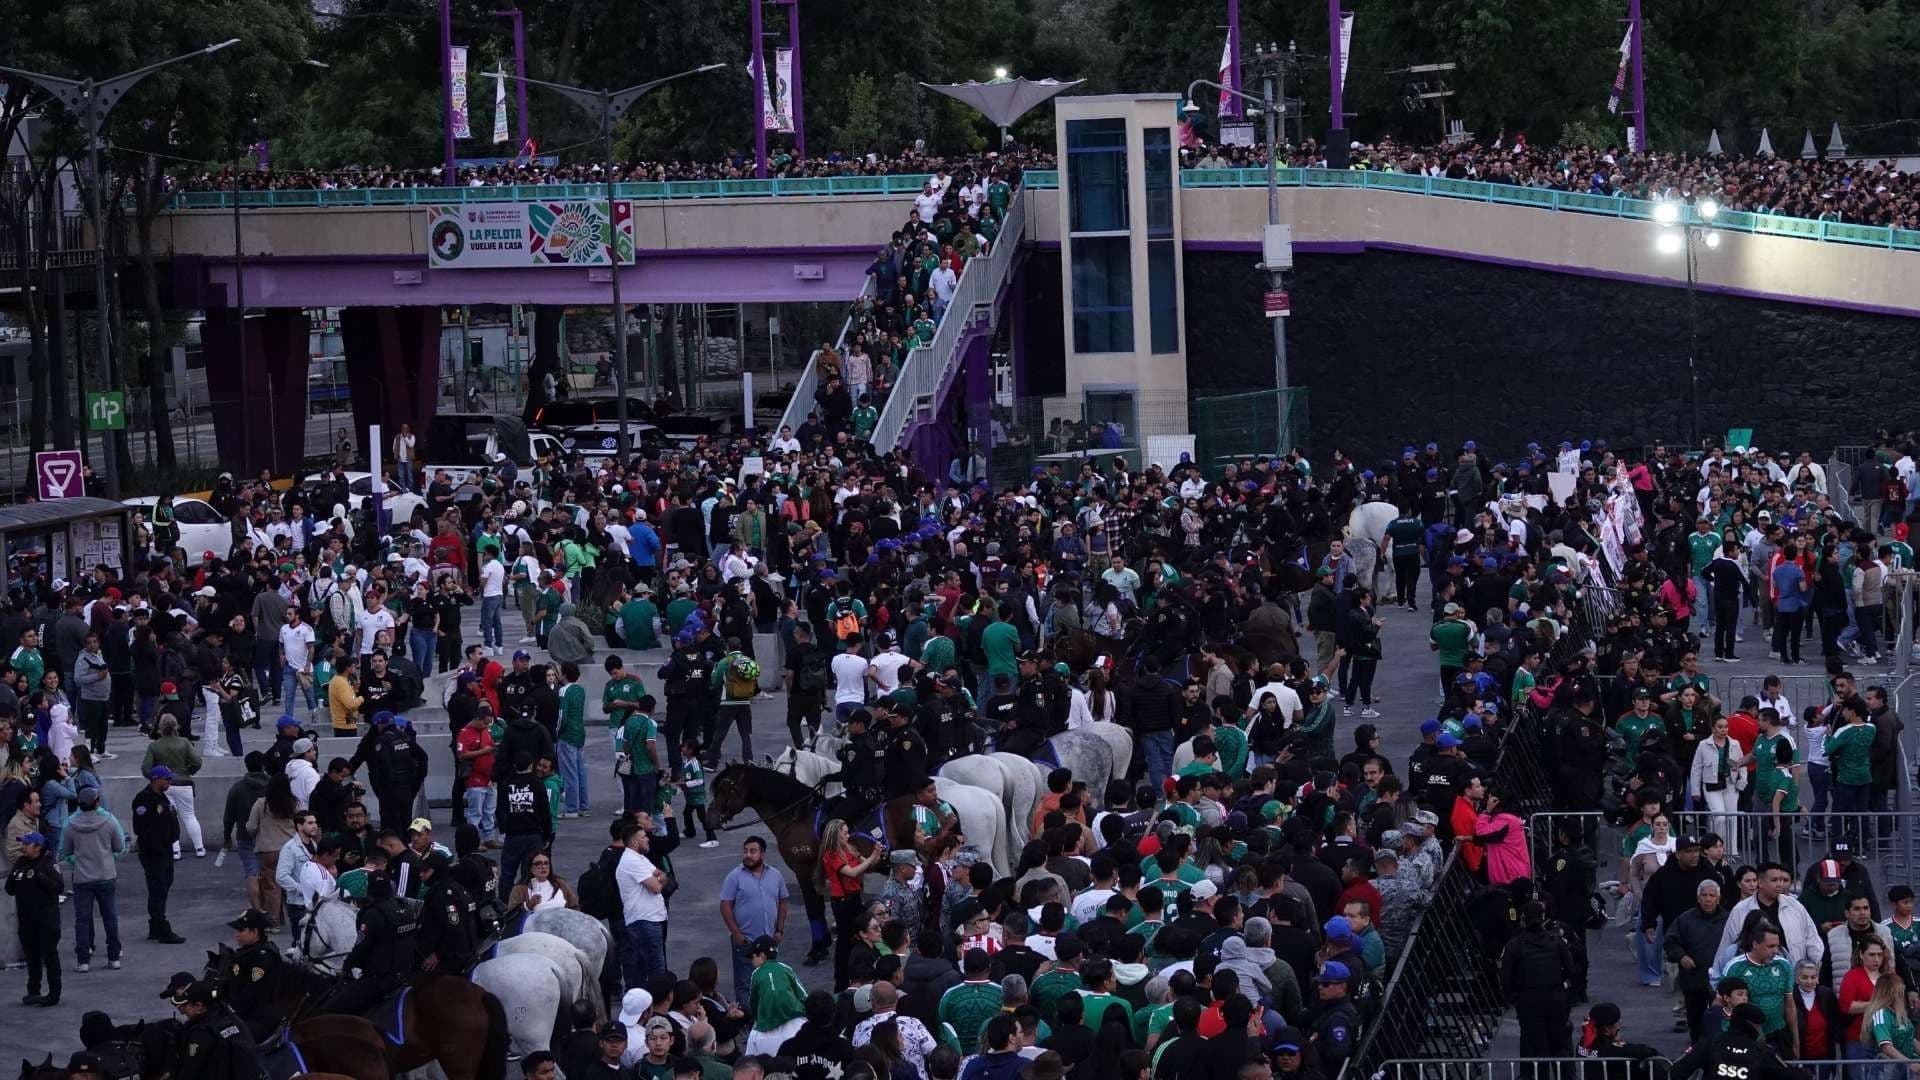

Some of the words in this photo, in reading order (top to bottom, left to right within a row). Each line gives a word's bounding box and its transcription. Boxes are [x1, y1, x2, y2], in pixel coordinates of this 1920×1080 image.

[470, 229, 482, 240] LA
[484, 228, 522, 240] PELOTA
[470, 242, 497, 250] VUELVE
[498, 242, 503, 250] A
[504, 241, 523, 250] CASA
[93, 396, 120, 425] rtp
[1717, 1063, 1749, 1080] SSC
